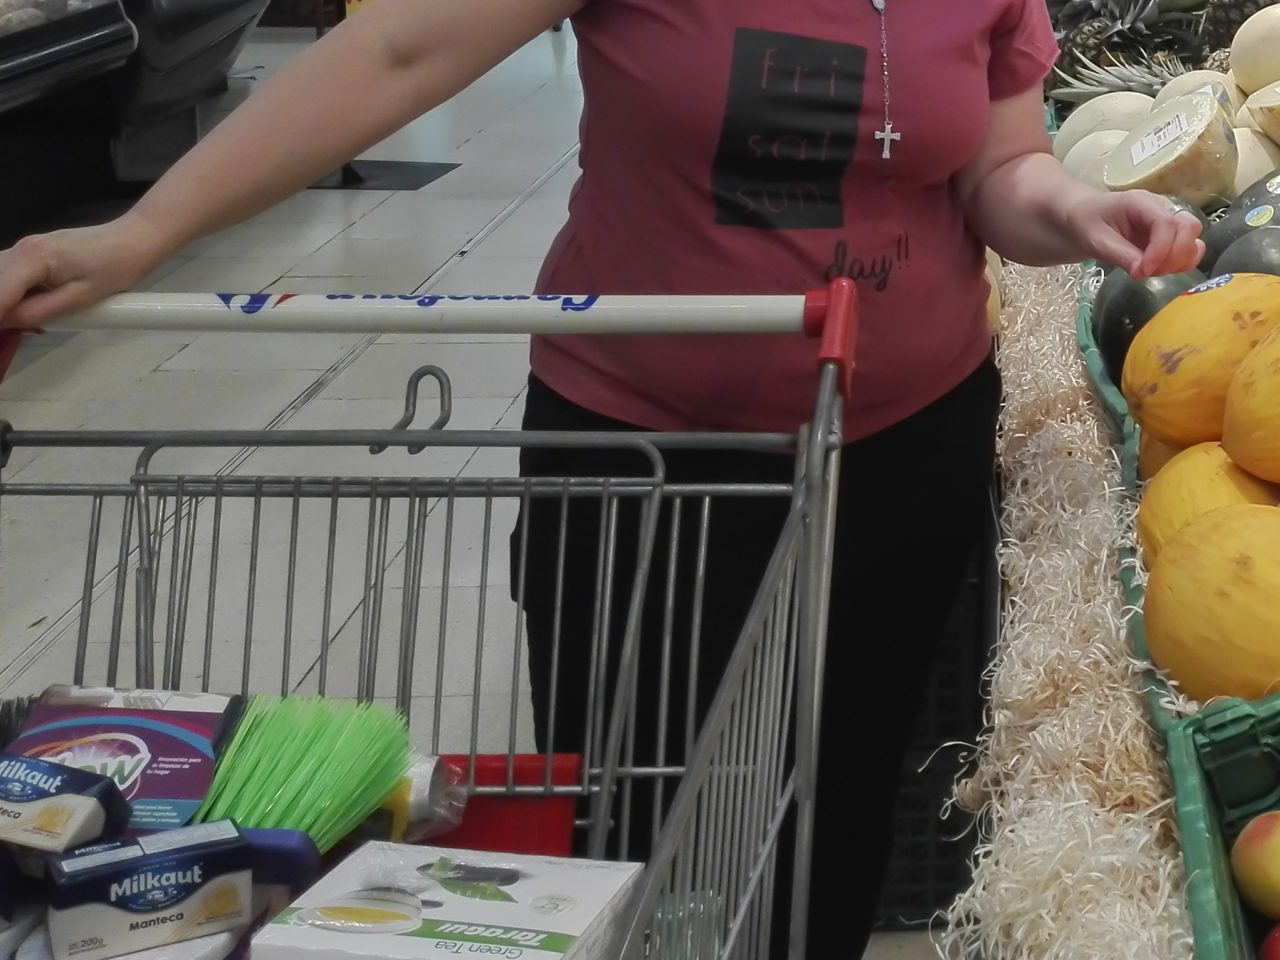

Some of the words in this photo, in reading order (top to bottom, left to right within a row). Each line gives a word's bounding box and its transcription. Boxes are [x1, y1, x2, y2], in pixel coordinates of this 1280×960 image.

[761, 47, 840, 97] fri
[110, 865, 203, 902] Milkaut
[129, 913, 185, 932] Manteca
[433, 940, 463, 954] Tea
[468, 945, 524, 960] Green
